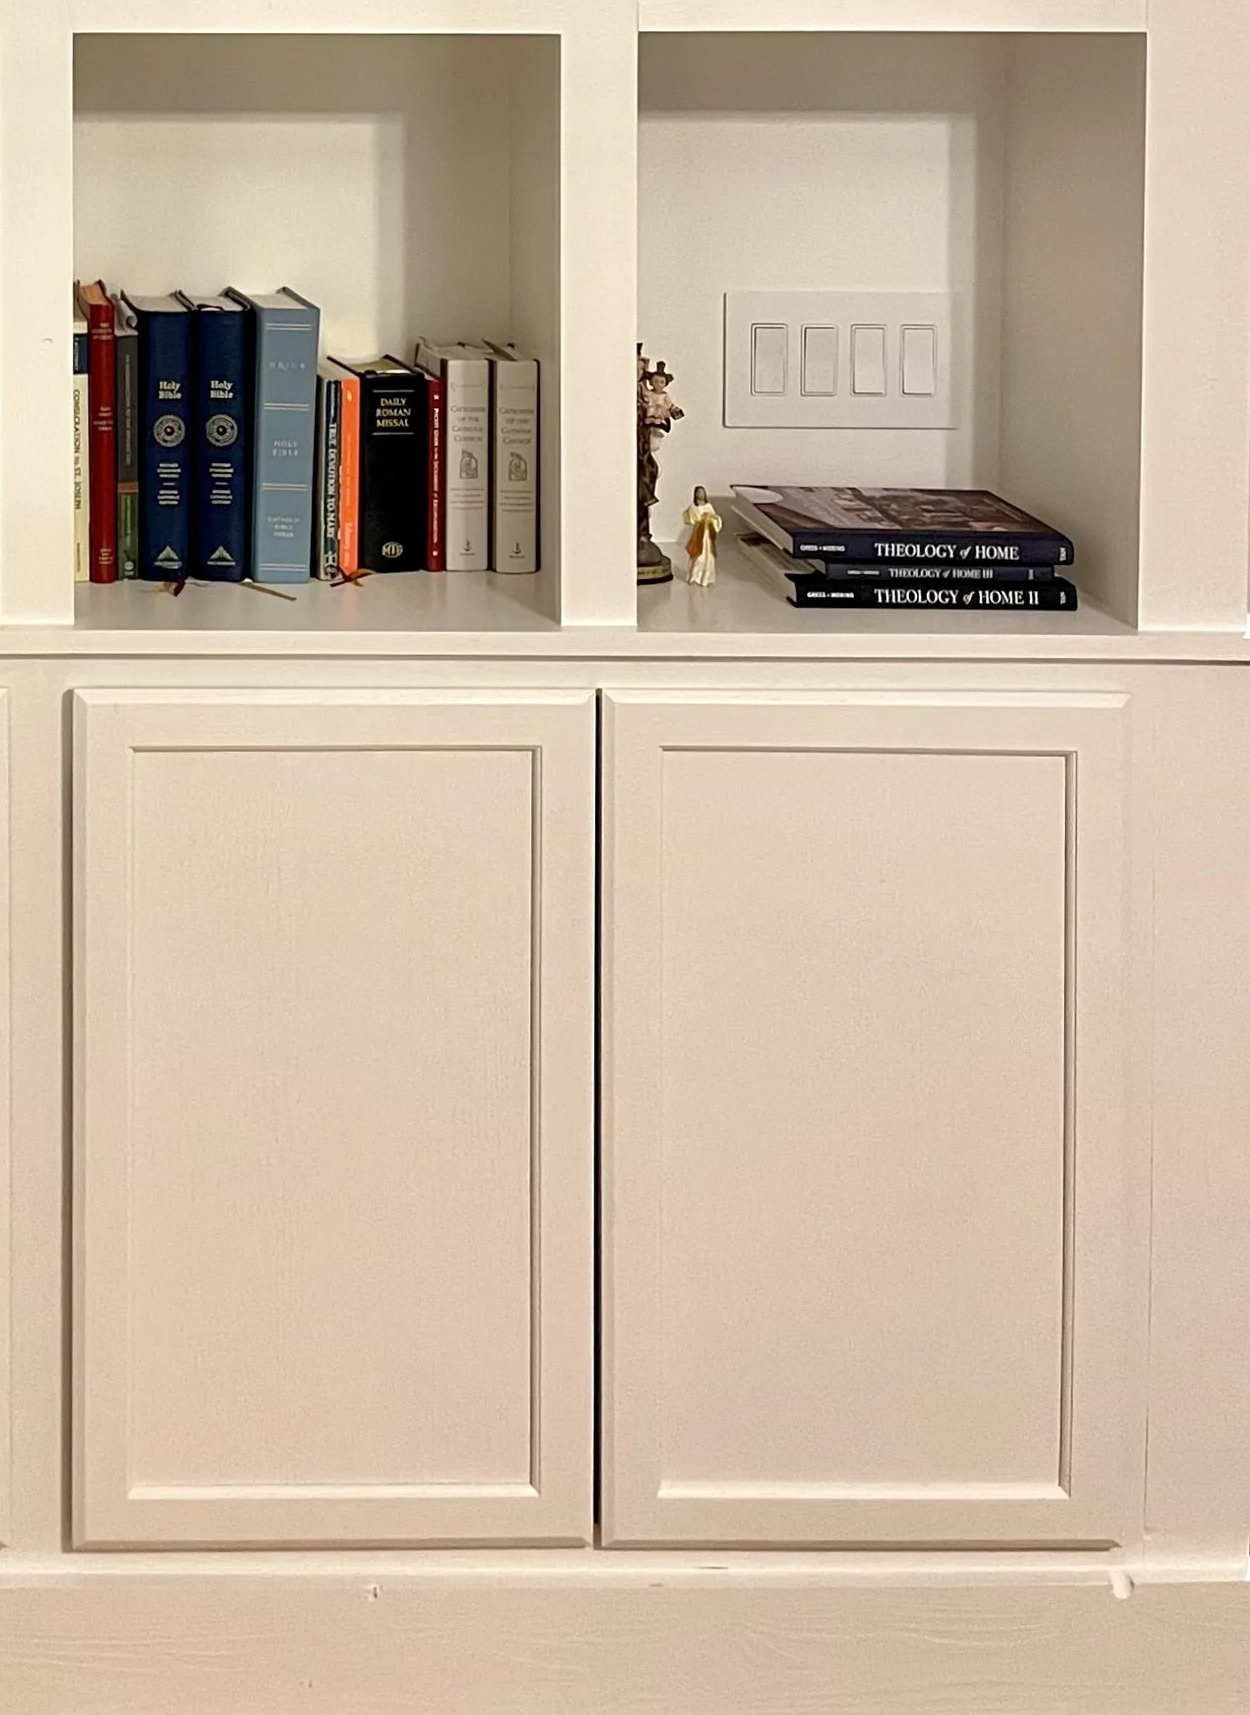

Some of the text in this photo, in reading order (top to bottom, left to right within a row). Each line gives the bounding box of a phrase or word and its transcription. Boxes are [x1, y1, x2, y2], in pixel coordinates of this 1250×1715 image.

[159, 381, 181, 391] Holy
[210, 380, 234, 390] Holy
[158, 390, 182, 399] Bible
[210, 390, 233, 399] Bible
[380, 397, 407, 407] DAILY
[376, 408, 411, 417] ROMAN
[376, 418, 410, 427] MISSAL
[327, 448, 336, 495] DEVOTION
[326, 512, 336, 538] MARY
[874, 542, 1019, 560] THEOLOGY of HOME
[889, 567, 941, 579] THEOLOGY
[953, 569, 981, 579] HOME
[983, 569, 994, 579] III
[874, 588, 1039, 605] THEOLOGY of HOME II
